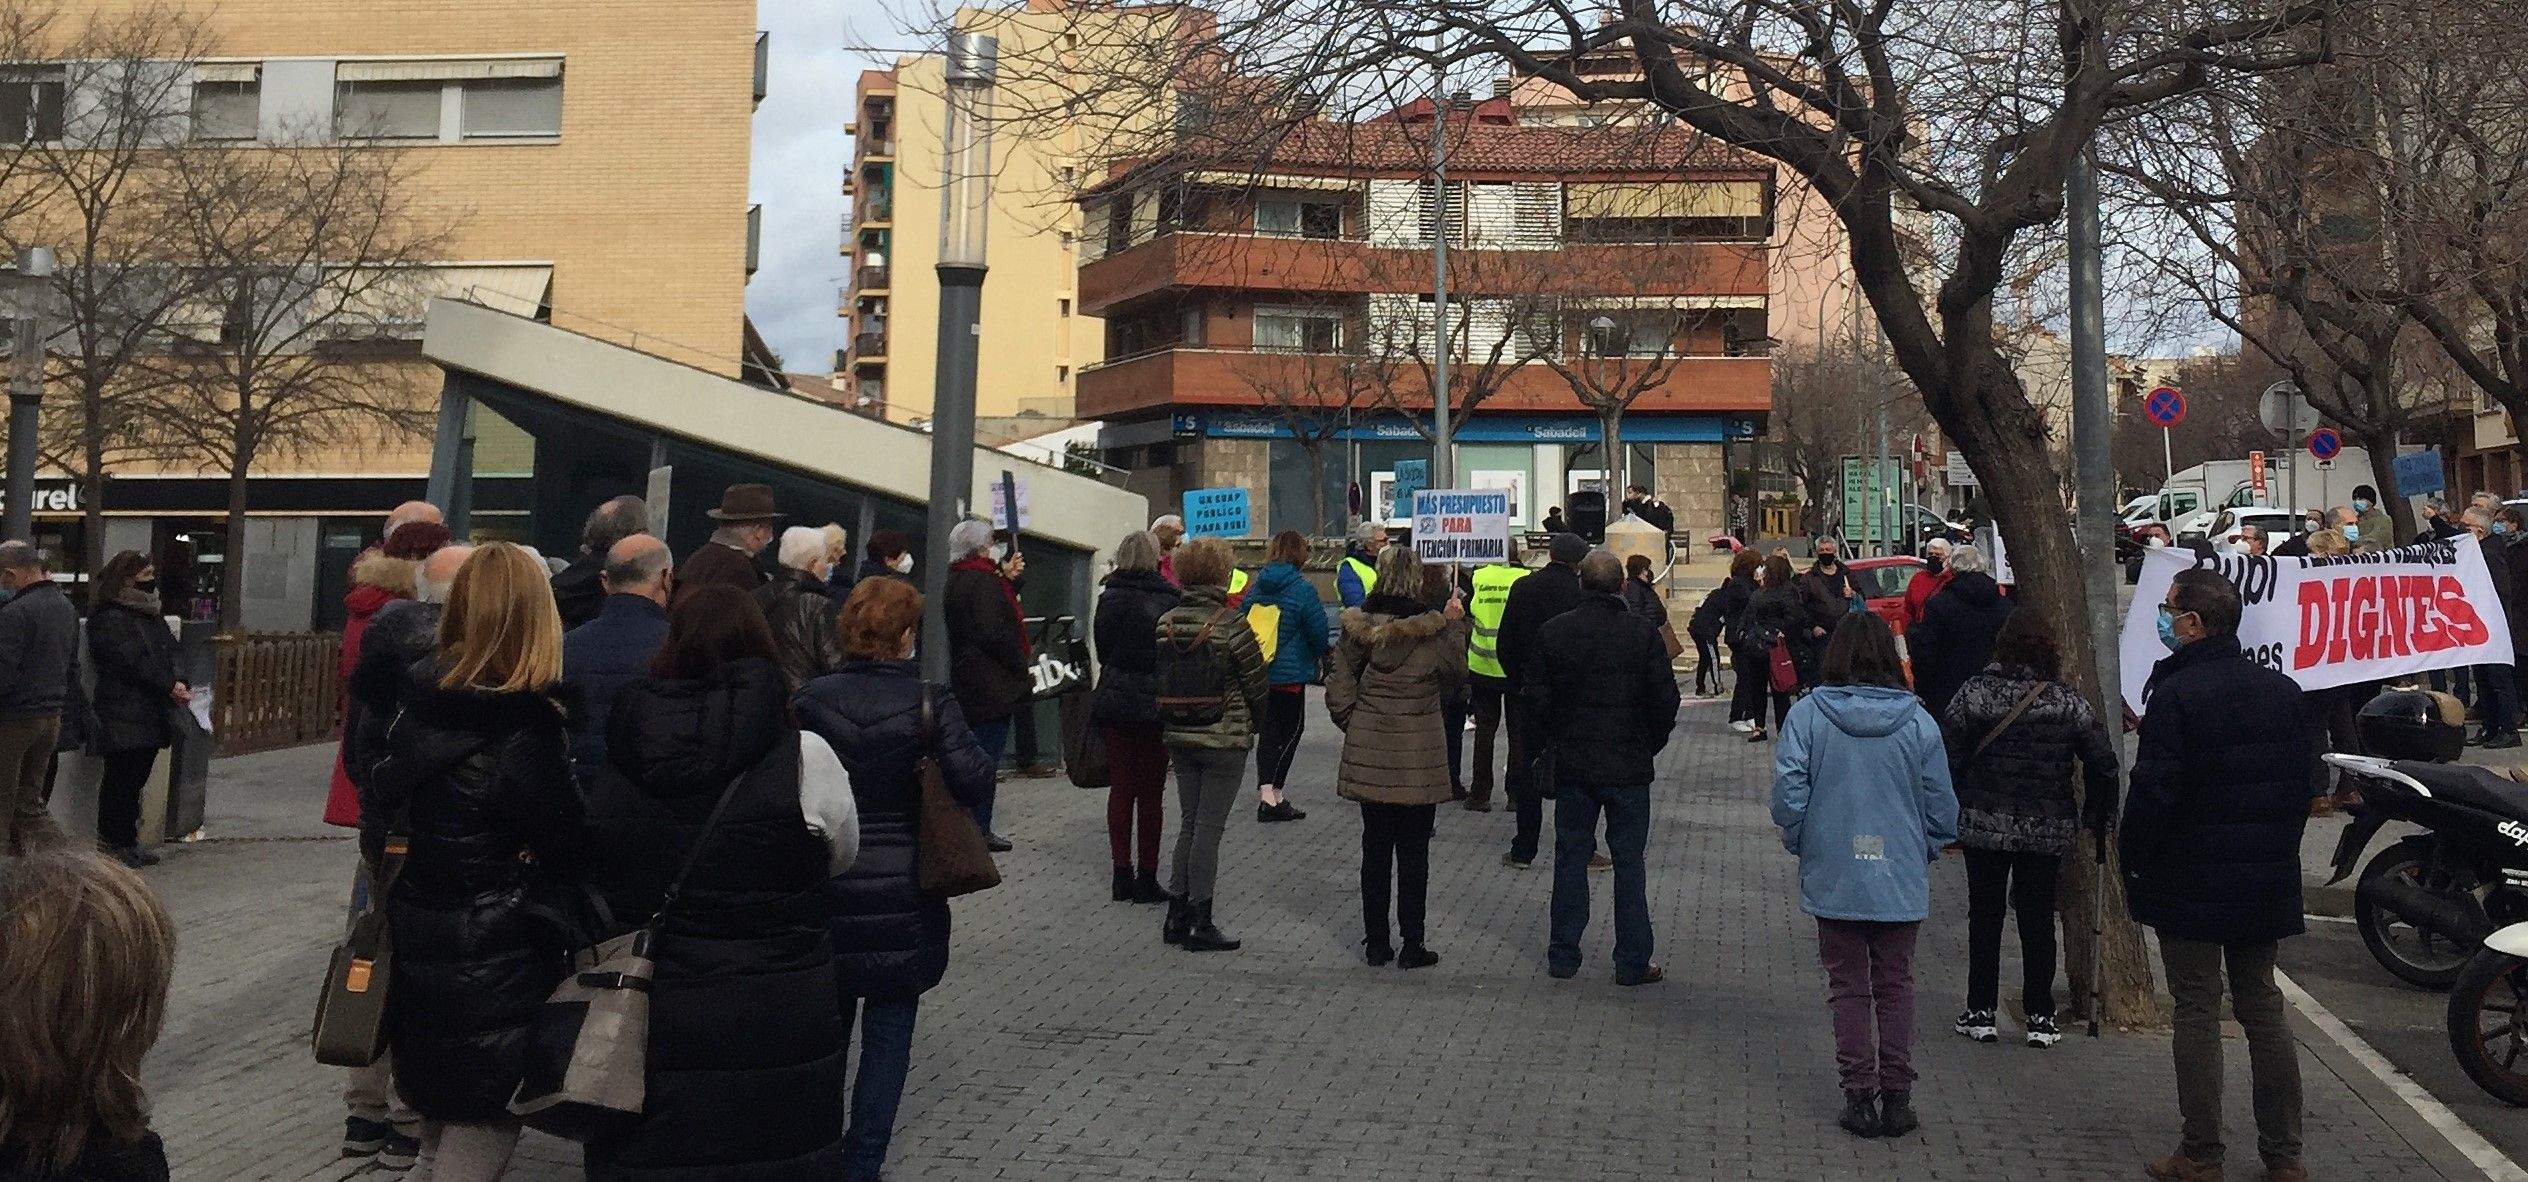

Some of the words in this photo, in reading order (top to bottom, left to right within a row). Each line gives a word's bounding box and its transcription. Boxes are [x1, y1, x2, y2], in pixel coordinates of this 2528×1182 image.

[1533, 424, 1587, 438] Sabadell
[1416, 492, 1438, 515] MÁS
[1440, 494, 1506, 515] PRESUPUESTO
[1441, 517, 1472, 533] PARA
[1415, 535, 1458, 558] ATENCIÓN
[1460, 538, 1504, 558] PRIMARIA
[2293, 575, 2490, 671] DIGNES
